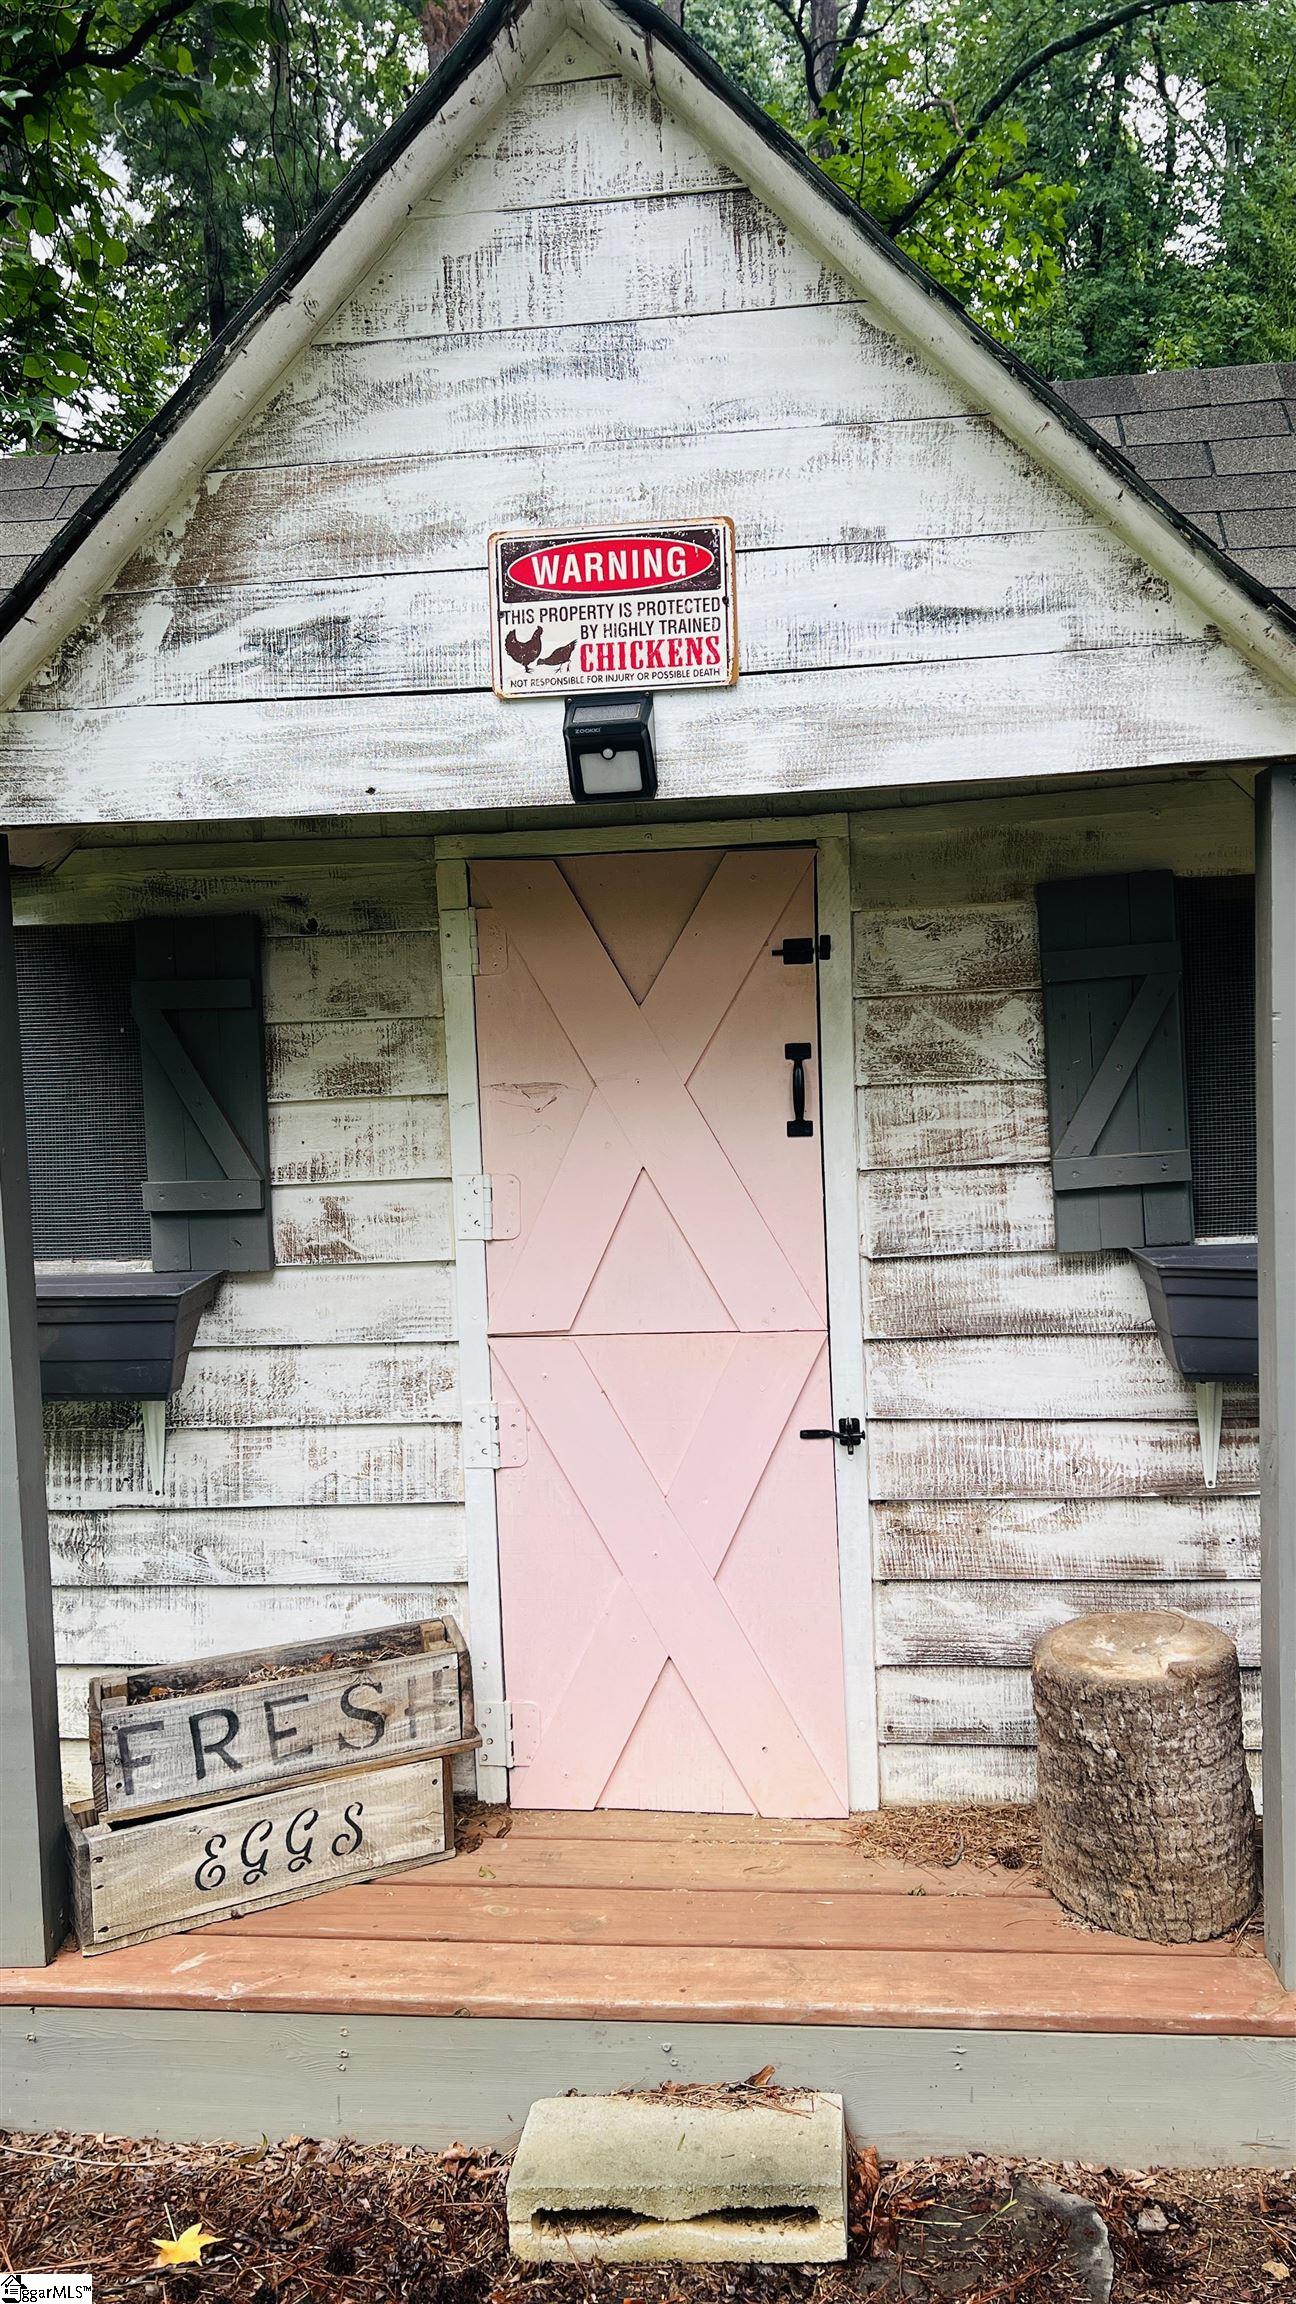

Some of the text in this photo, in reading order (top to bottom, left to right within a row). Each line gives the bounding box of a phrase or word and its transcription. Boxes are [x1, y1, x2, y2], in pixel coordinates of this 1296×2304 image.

[531, 546, 687, 586] WARNING
[503, 596, 721, 625] THIS PROPERTY IS PROTECTED
[580, 616, 721, 640] BY HIGHLY TRAINED
[580, 635, 721, 672] CHICKENS
[510, 668, 721, 688] NOT RESPONSIBLE FOR INJURY OR POSSIBLE DEATH
[115, 1670, 443, 1796] FRESH
[194, 1801, 364, 1891] EGGS
